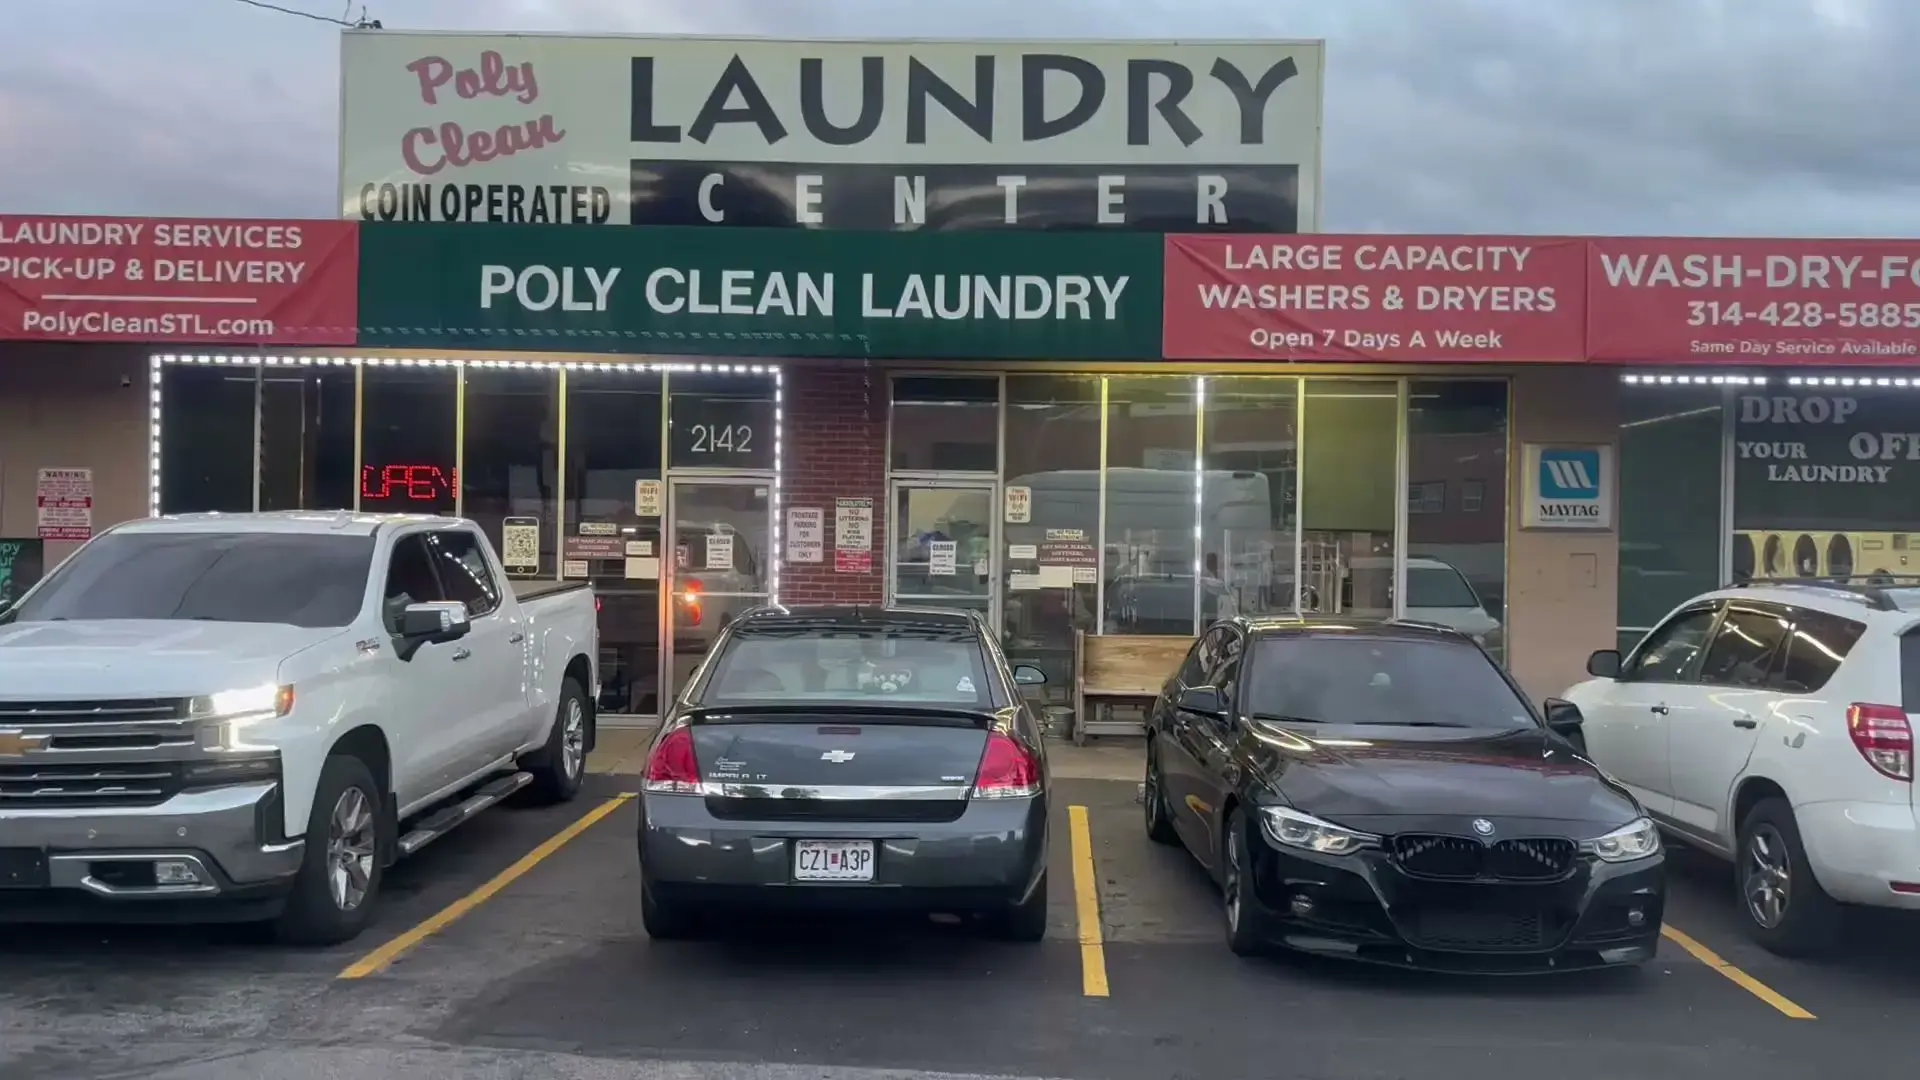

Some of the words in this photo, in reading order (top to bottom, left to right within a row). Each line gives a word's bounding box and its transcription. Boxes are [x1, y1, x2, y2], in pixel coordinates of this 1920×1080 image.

[406, 50, 539, 104] Poly
[630, 53, 1298, 147] LAUNDRY
[402, 114, 566, 176] Clean
[360, 182, 432, 222] COIN
[440, 183, 611, 224] OPERATED
[699, 172, 1229, 224] CENTER
[0, 221, 144, 245] LAUNDRY
[154, 224, 303, 248] SERVICES
[0, 256, 116, 280] PICK-UP
[124, 258, 144, 281] &
[154, 259, 305, 284] DELIVERY
[1225, 244, 1343, 270] LARGE
[1354, 245, 1531, 272] CAPACITY
[1601, 254, 1920, 289] WASH-DRY-F
[480, 265, 621, 312] POLY
[645, 268, 834, 317] CLEAN
[861, 273, 1130, 320] LAUNDRY
[1198, 284, 1370, 310] WASHERS
[1381, 285, 1405, 311] &
[1417, 286, 1556, 312] DRYERS
[23, 311, 274, 335] PolyCleanSTL.com
[1687, 300, 1920, 328] 314-428-5885
[1250, 328, 1314, 350] Open
[1322, 329, 1336, 346] 7
[1344, 330, 1401, 351] Days
[1408, 330, 1426, 348] A
[1434, 330, 1503, 348] Week
[1690, 340, 1735, 353] Same
[1740, 341, 1771, 355] Day
[1775, 341, 1836, 355] Service
[1841, 341, 1917, 355] Available
[1740, 396, 1857, 424] DROP
[690, 425, 752, 453] 2142
[1737, 441, 1808, 459] YOUR
[362, 464, 457, 499] OPEN
[1768, 464, 1892, 483] LAUNDRY
[1540, 504, 1600, 516] MAYTAG
[840, 849, 871, 871] A3P
